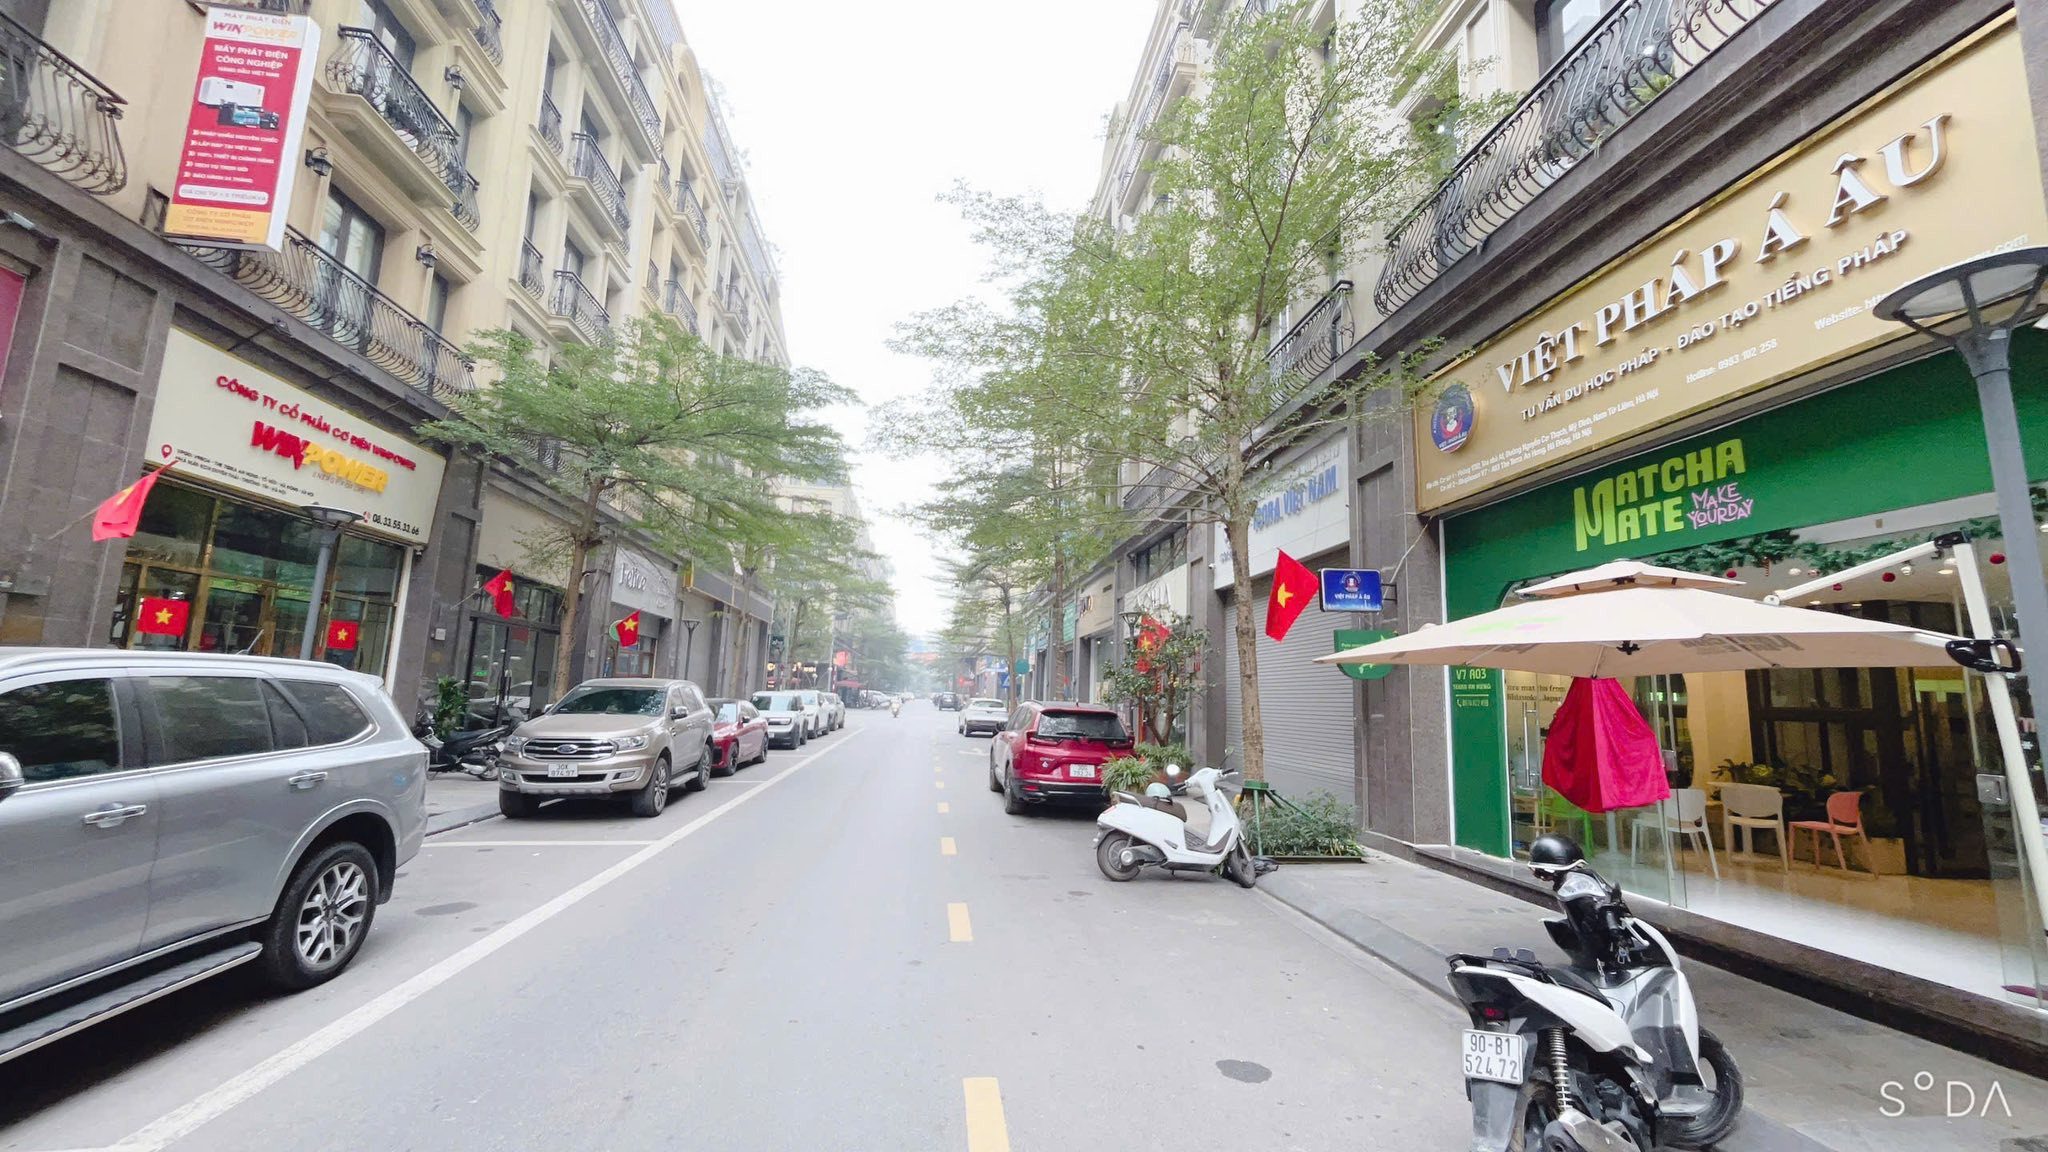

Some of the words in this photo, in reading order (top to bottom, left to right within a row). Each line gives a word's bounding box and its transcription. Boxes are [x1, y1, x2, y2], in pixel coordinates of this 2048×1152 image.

[1496, 321, 1589, 394] VIỆT
[1594, 238, 1742, 348] PHÁP
[1755, 191, 1811, 264] Á
[1823, 112, 1953, 229] ÂU
[1619, 346, 1660, 377] PHÁP
[1718, 301, 1760, 330] TẠO
[1837, 229, 1909, 276] PHÁP
[216, 375, 259, 402] CÔNG
[263, 394, 278, 410] TY
[1307, 464, 1337, 503] NAM
[1691, 482, 1742, 509] MAKE
[1456, 669, 1467, 680] V7
[1470, 1033, 1511, 1057] 90-B1
[1465, 1053, 1519, 1081] 524.72
